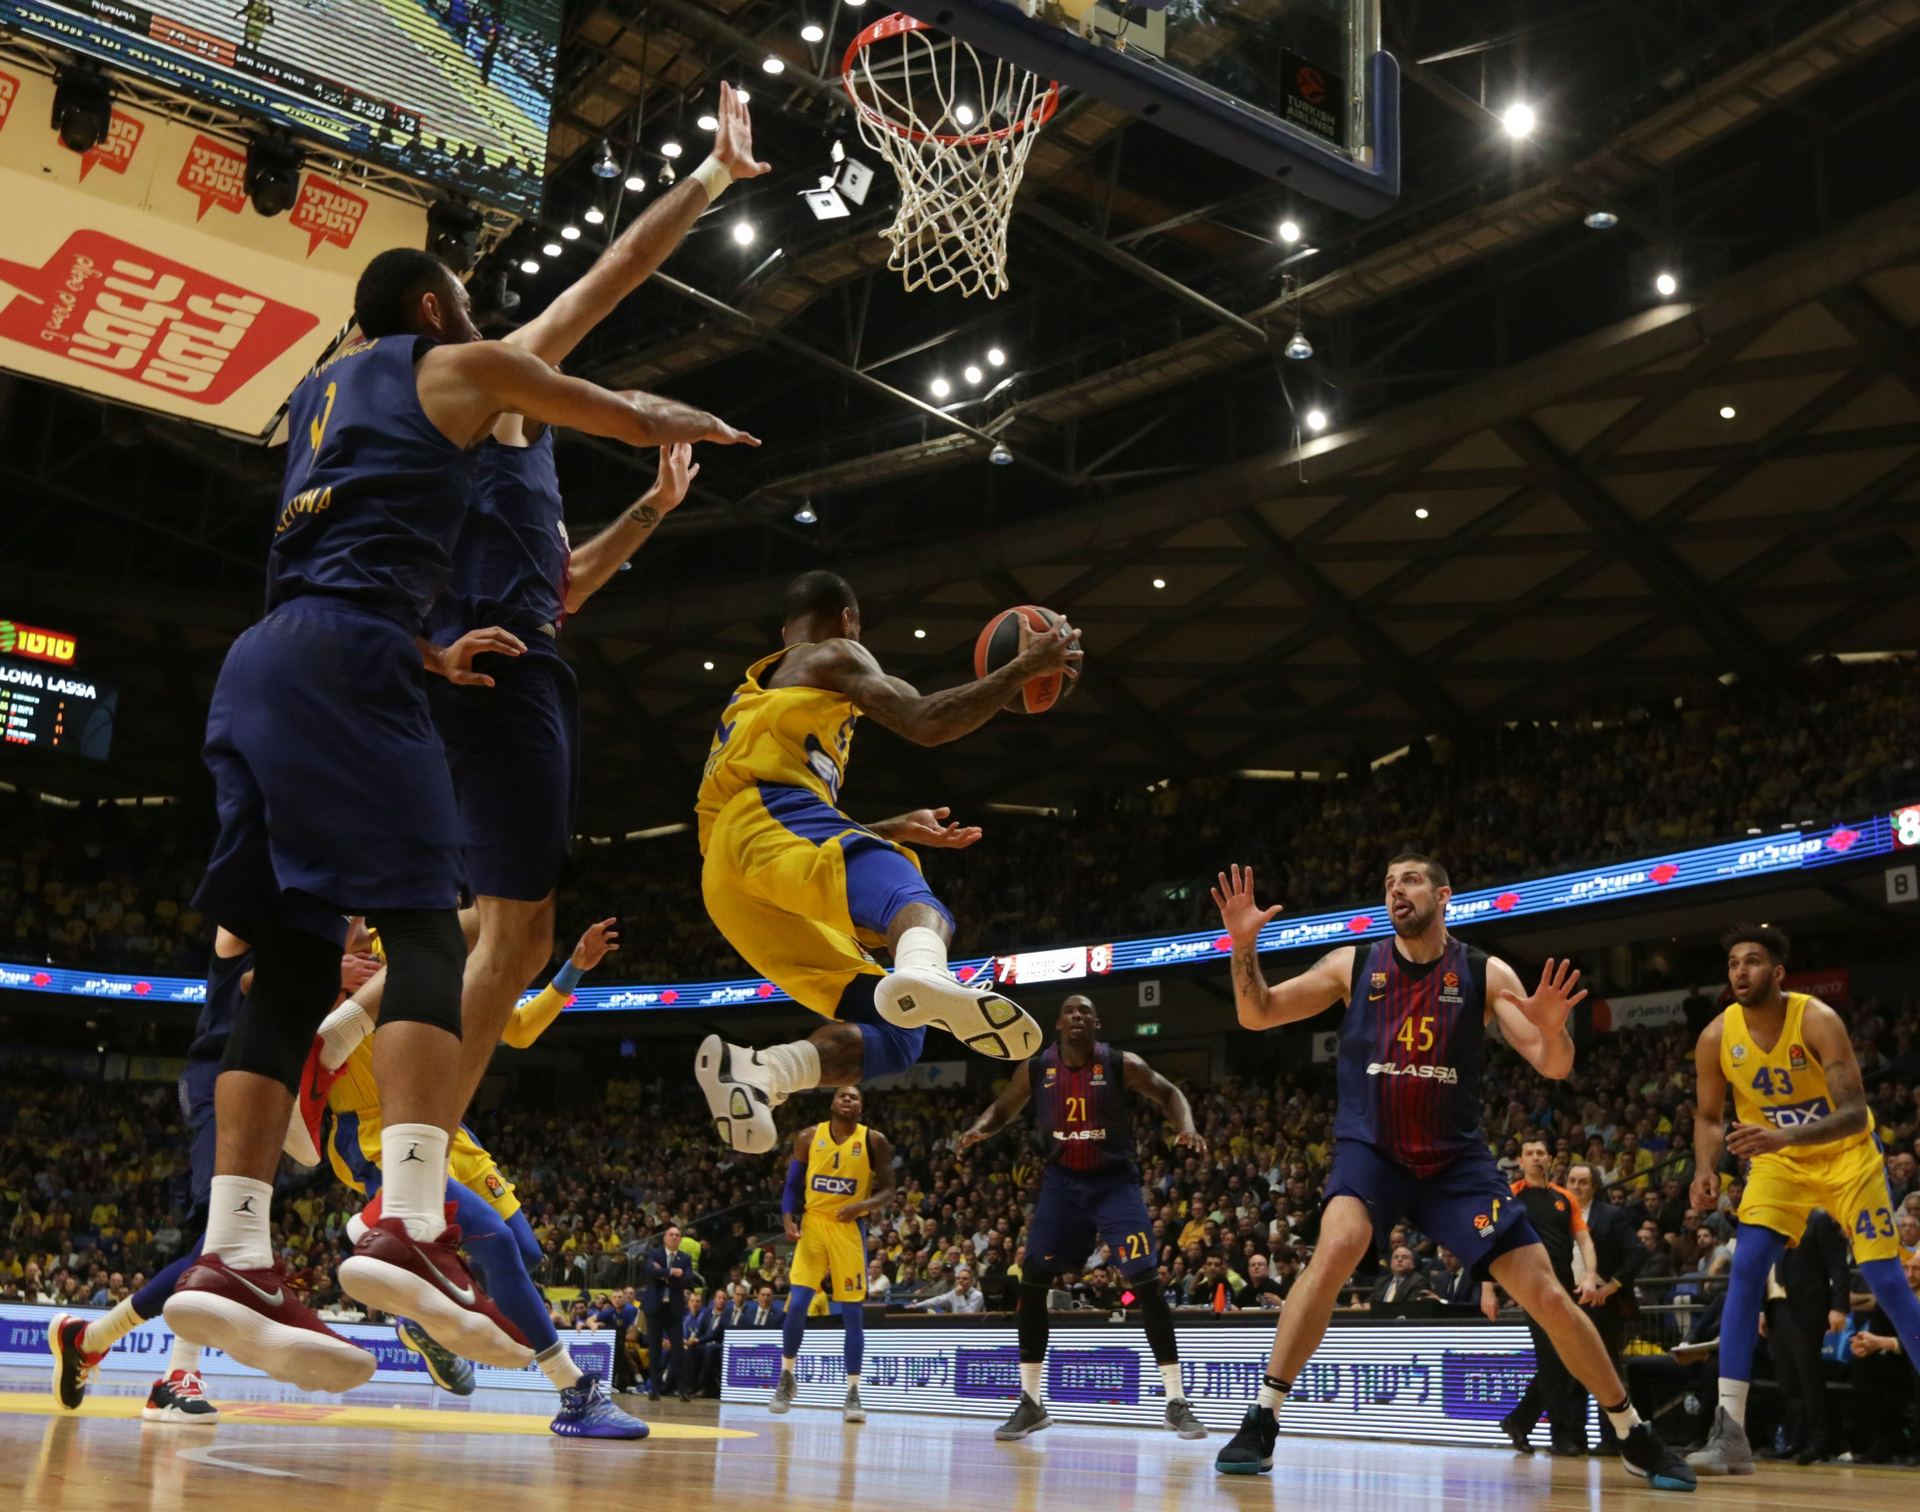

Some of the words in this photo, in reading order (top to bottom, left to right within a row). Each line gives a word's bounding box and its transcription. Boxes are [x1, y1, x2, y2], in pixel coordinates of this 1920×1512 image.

[1286, 106, 1335, 136] AIRLINES
[1287, 94, 1335, 125] TURKISH
[193, 146, 248, 178] עדני
[300, 201, 357, 235] הטלה
[67, 259, 186, 370] הטלה
[140, 293, 266, 393] מעדני
[18, 631, 75, 660] טוטו
[1898, 809, 1919, 846] 8
[1894, 873, 1909, 895] 8
[997, 958, 1011, 983] 7
[1090, 946, 1107, 974] 8
[1144, 985, 1154, 1002] 8
[1397, 1016, 1435, 1051] 45
[1386, 1062, 1458, 1083] LASSA
[1752, 1066, 1794, 1097] 43
[1066, 1097, 1086, 1122] 21
[1056, 1129, 1106, 1141] LASSA
[832, 1151, 840, 1169] 1
[814, 1178, 853, 1193] FOX
[1855, 1207, 1895, 1240] 43
[1126, 1232, 1149, 1259] 21
[856, 1272, 863, 1290] 1
[10, 1327, 48, 1346] ינח
[818, 1355, 845, 1385] יות
[903, 1349, 949, 1394] לישון
[1349, 1353, 1431, 1415] לישון
